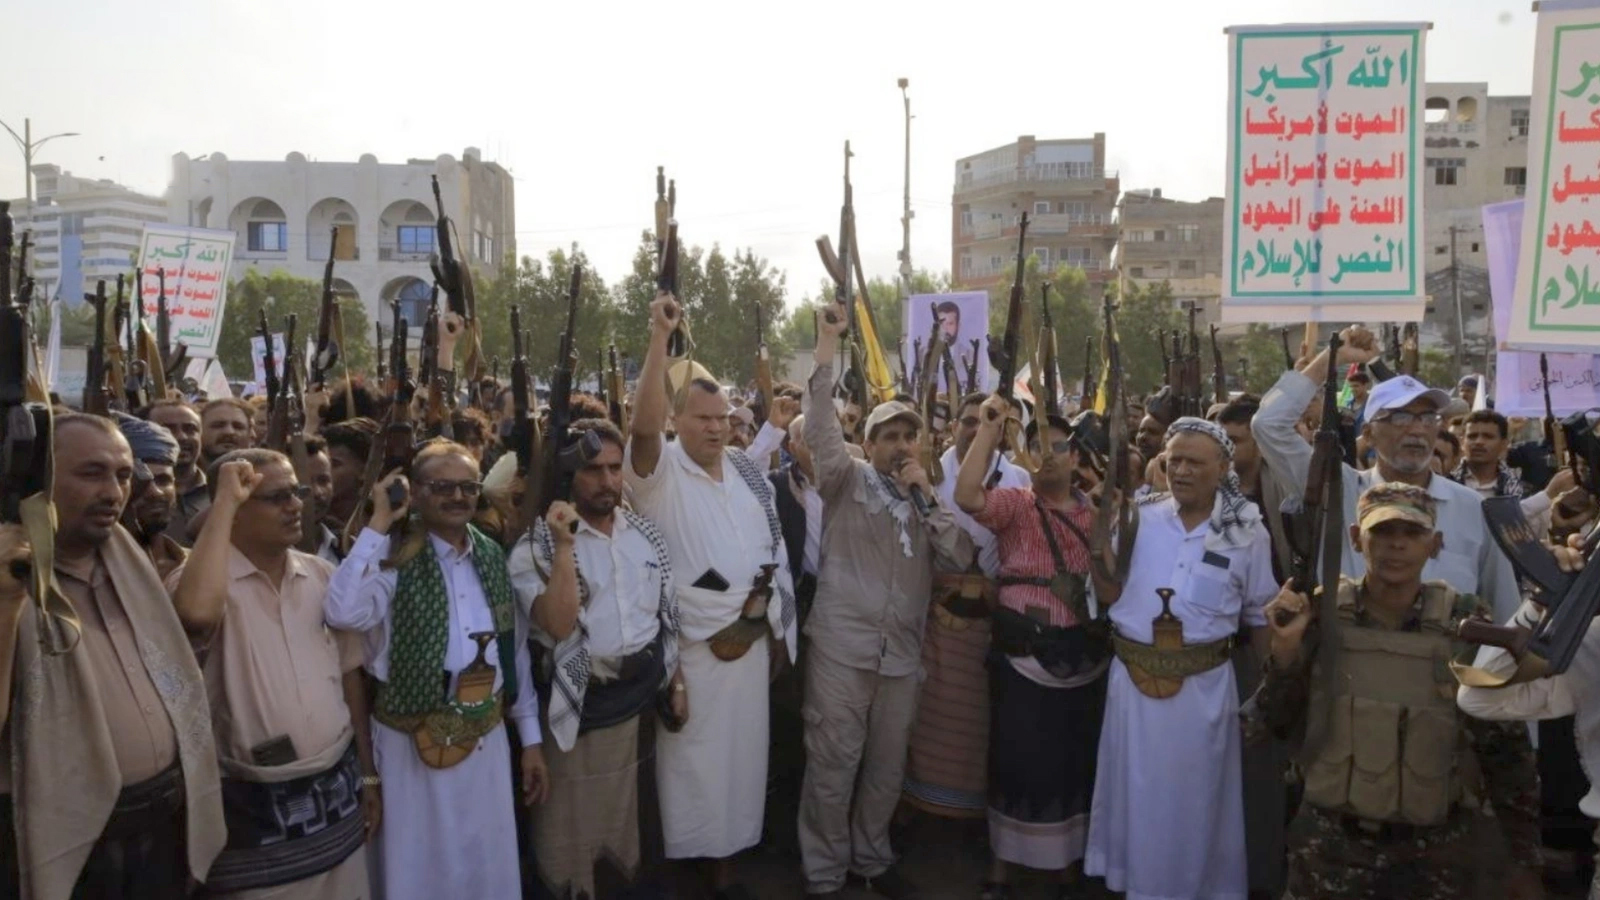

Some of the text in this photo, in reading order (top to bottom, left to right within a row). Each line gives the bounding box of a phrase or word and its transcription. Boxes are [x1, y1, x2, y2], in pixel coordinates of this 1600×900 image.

[1245, 40, 1345, 103] أكبر
[1335, 105, 1405, 141] الموت
[1333, 151, 1404, 186] الموت
[1242, 195, 1404, 232] اللعنة على اليهود
[1241, 233, 1404, 288] النصر للإسلام
